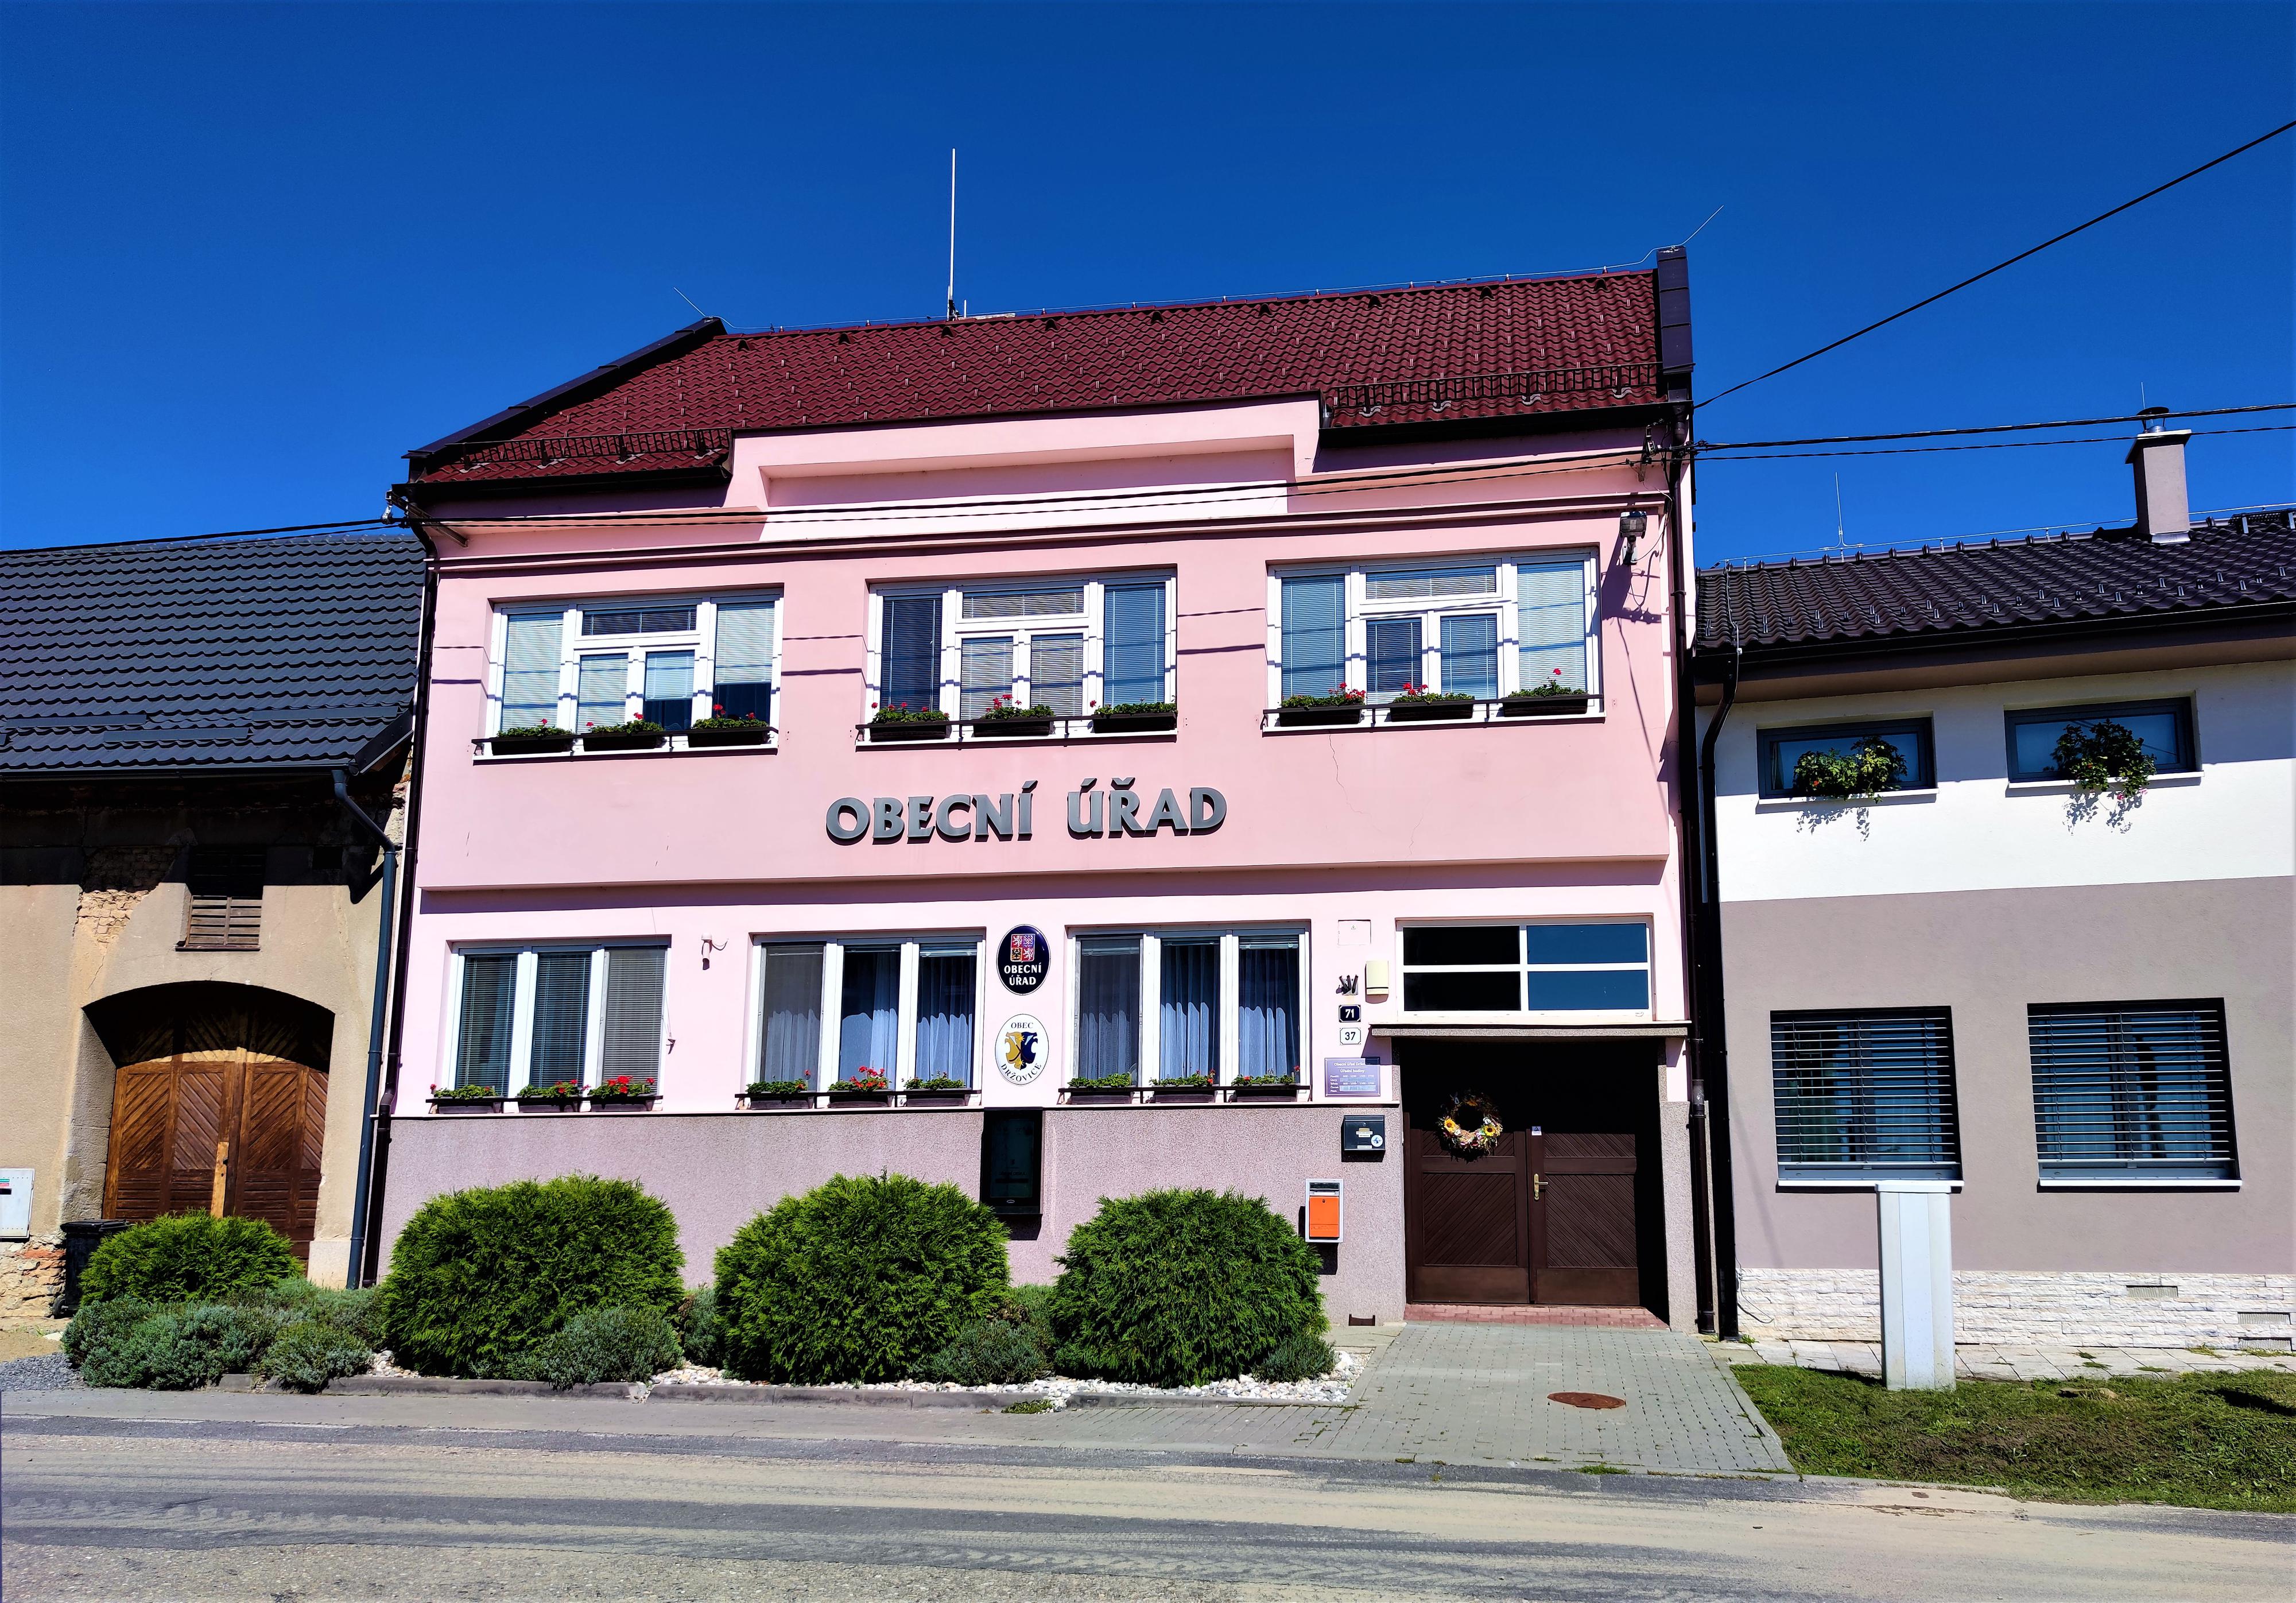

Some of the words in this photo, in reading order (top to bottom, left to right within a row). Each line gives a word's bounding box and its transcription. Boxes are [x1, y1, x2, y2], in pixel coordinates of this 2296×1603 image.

[825, 779, 1038, 845] OBECNÍ
[1067, 777, 1227, 839] ÚŘAD
[1004, 962, 1042, 974] OBECNÍ
[1009, 974, 1037, 986] ÚŘAD
[1345, 1008, 1354, 1018] 71
[1345, 1032, 1356, 1040] 37
[1001, 1063, 1042, 1082] DRŽOVICE
